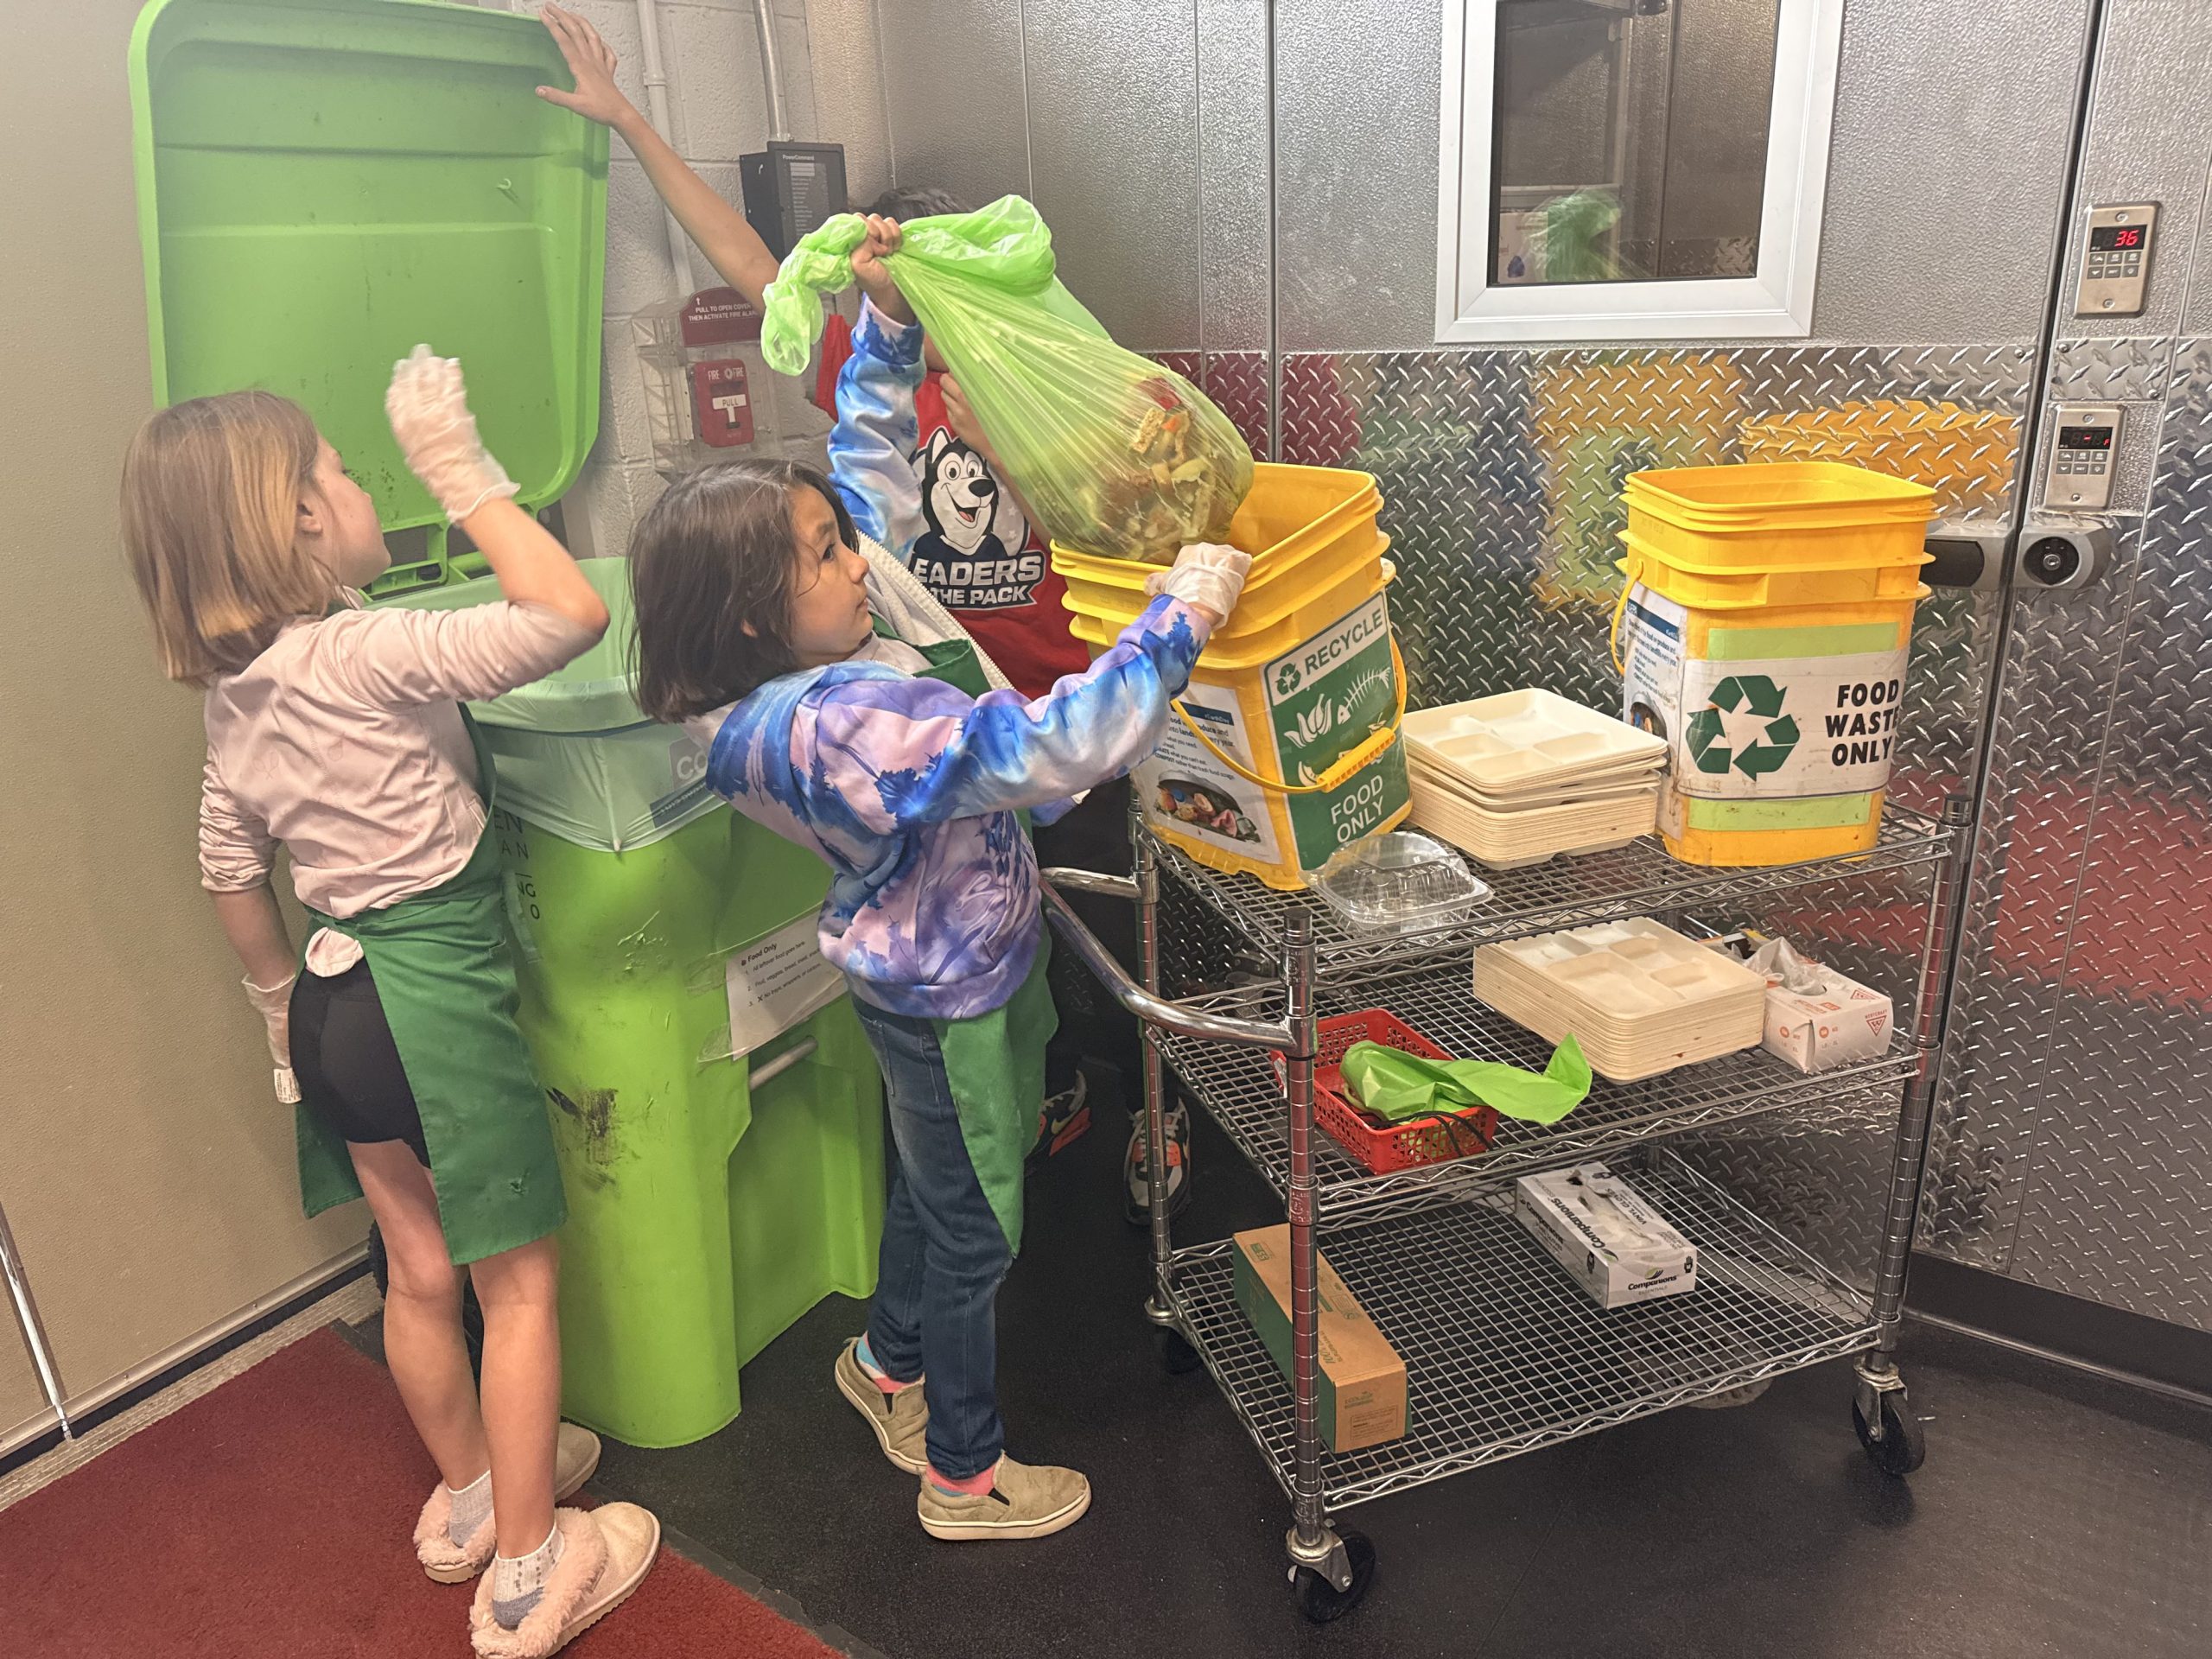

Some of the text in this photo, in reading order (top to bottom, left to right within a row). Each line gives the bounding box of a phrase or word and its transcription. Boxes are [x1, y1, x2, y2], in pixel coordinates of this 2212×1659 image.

[2114, 229, 2139, 247] 36
[708, 367, 745, 381] FIRE FIRE
[722, 398, 739, 407] PULL
[913, 556, 1041, 586] EADERS
[969, 584, 1029, 605] PACK
[1304, 607, 1383, 675] RECYCLE
[1837, 679, 1899, 708] FOOD
[1832, 735, 1893, 766] ONLY
[1331, 774, 1383, 825] FOOD
[1337, 795, 1383, 843] ONLY
[747, 943, 778, 962] Food Only
[775, 951, 785, 960] food
[1605, 1187, 1630, 1209] GLOVES
[1551, 1198, 1605, 1249] Companions
[1629, 1208, 1648, 1225] VINYL
[1628, 1274, 1678, 1292] Companions
